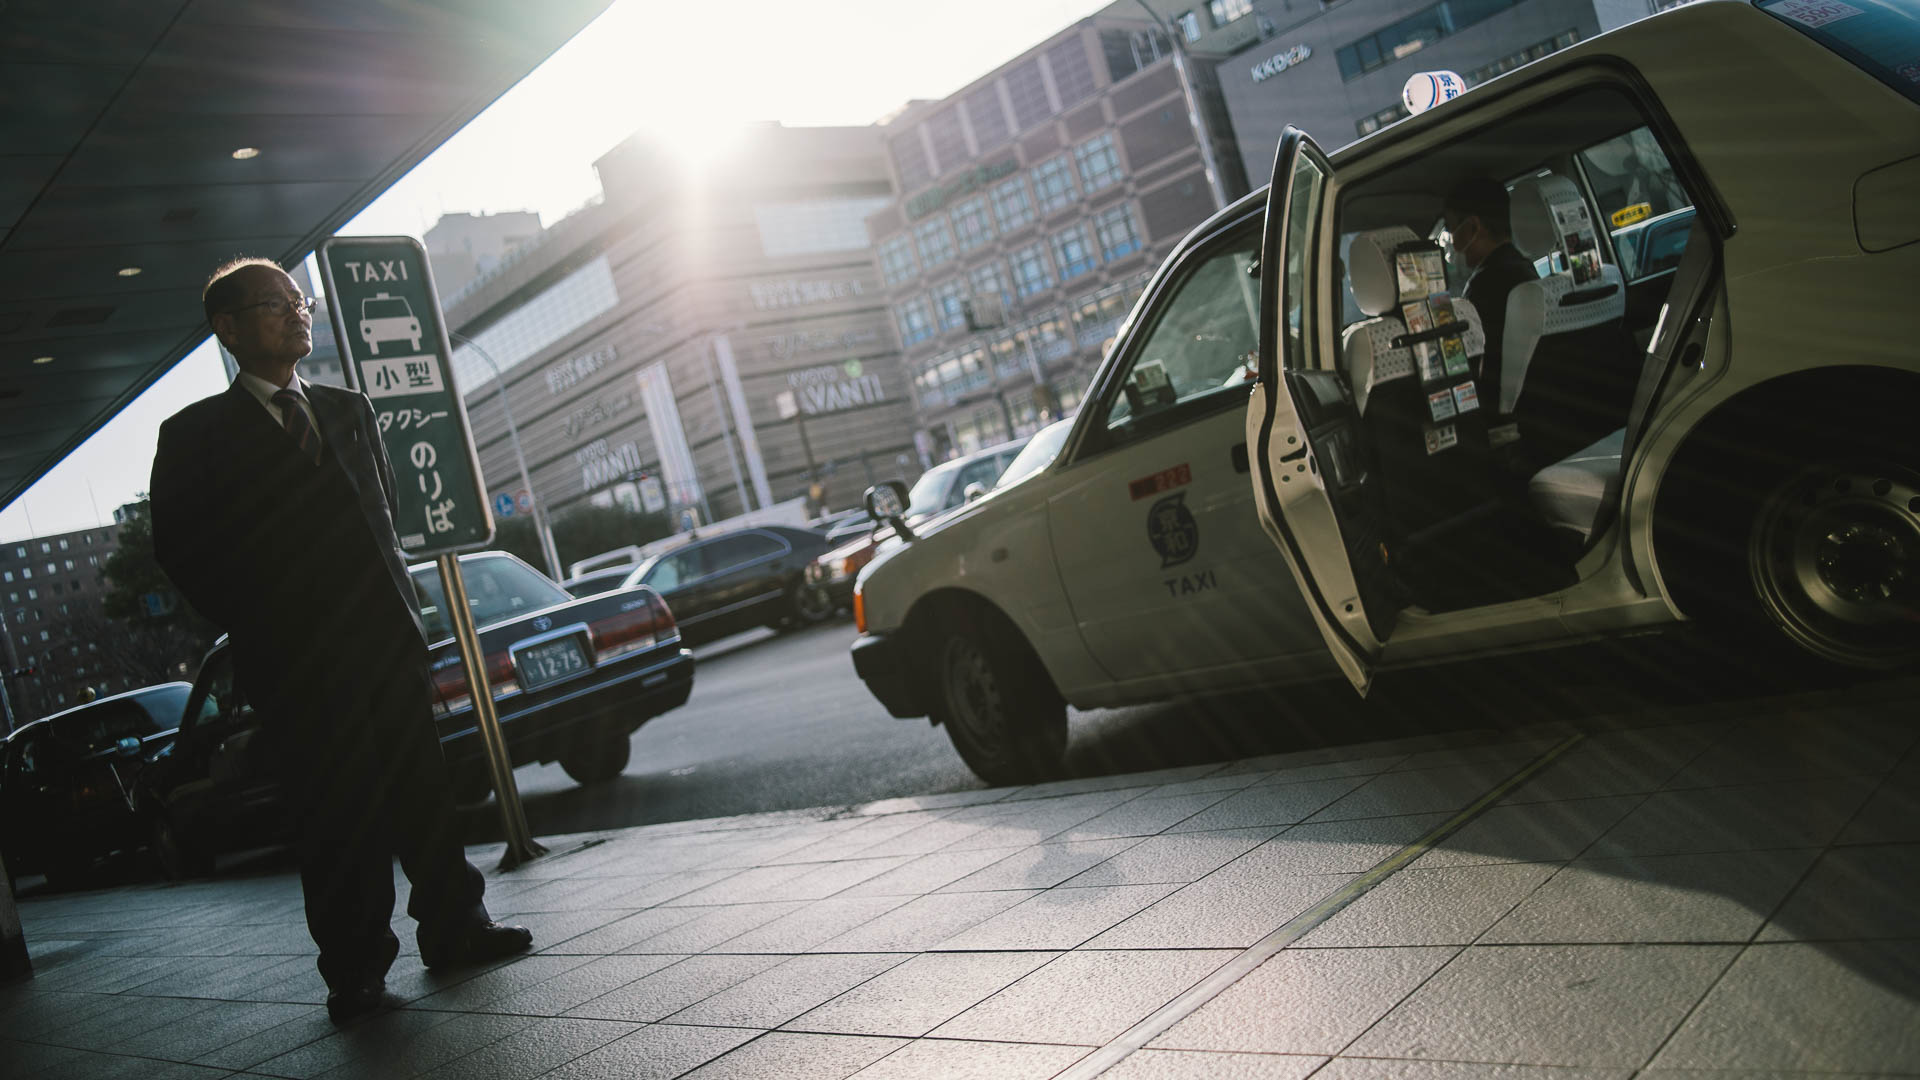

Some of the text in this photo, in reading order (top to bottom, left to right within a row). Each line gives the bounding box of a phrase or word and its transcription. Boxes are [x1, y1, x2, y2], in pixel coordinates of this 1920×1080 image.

[345, 260, 408, 283] TAXI
[376, 361, 434, 390] 小型
[799, 374, 885, 415] AVANTI
[378, 408, 448, 432] タクシー
[410, 441, 455, 534] のりば
[1164, 569, 1218, 597] TAXI
